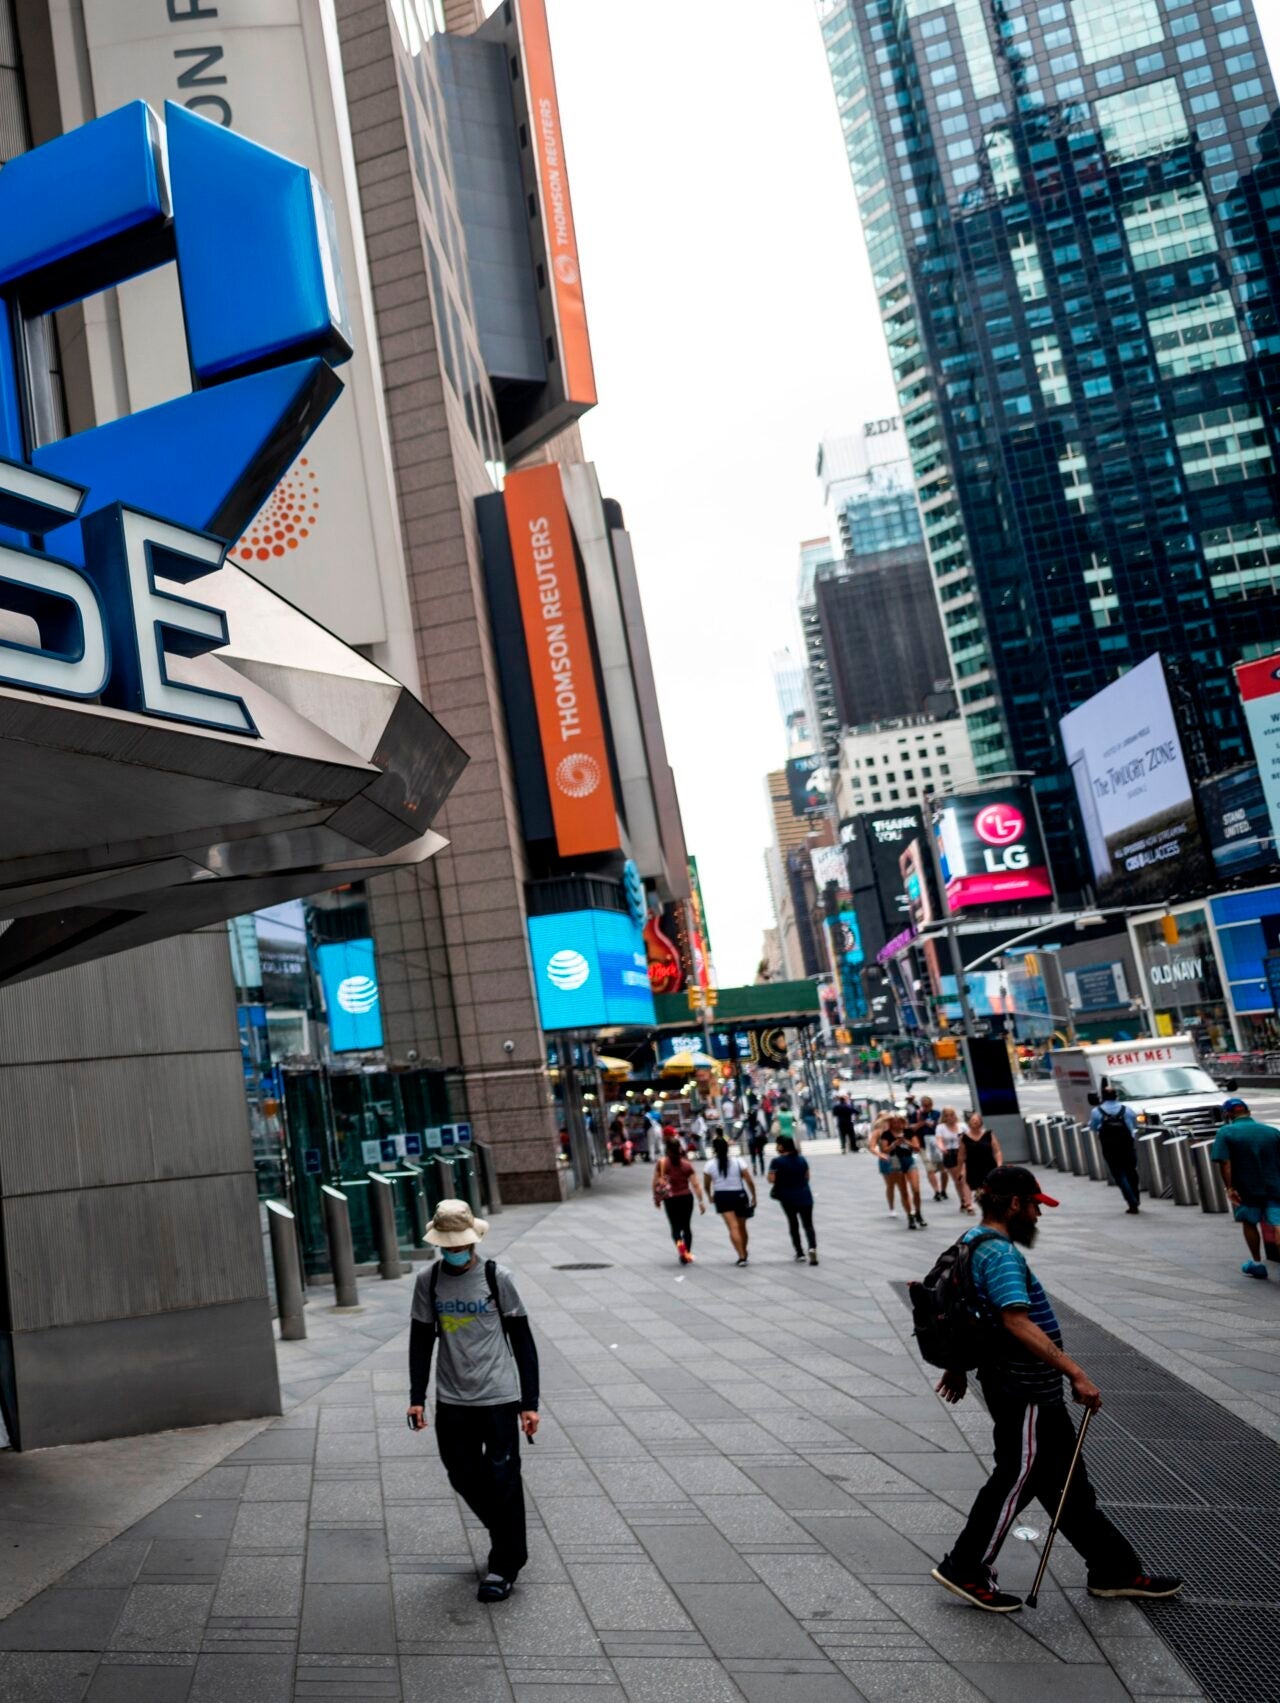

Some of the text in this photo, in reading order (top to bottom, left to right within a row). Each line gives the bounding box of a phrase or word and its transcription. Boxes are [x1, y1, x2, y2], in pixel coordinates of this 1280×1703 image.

[539, 97, 569, 246] THOMSON REUTERS
[528, 515, 581, 743] THOMSON REUTERS
[1145, 740, 1177, 771] ZONE
[873, 816, 918, 832] THANK
[1222, 807, 1246, 826] STAND
[876, 829, 903, 843] YOU
[983, 844, 1030, 872] LG
[1150, 958, 1204, 986] OLD NAVY
[1106, 1051, 1140, 1067] RENT
[1145, 1049, 1164, 1062] ME
[435, 1299, 489, 1314] eebok
